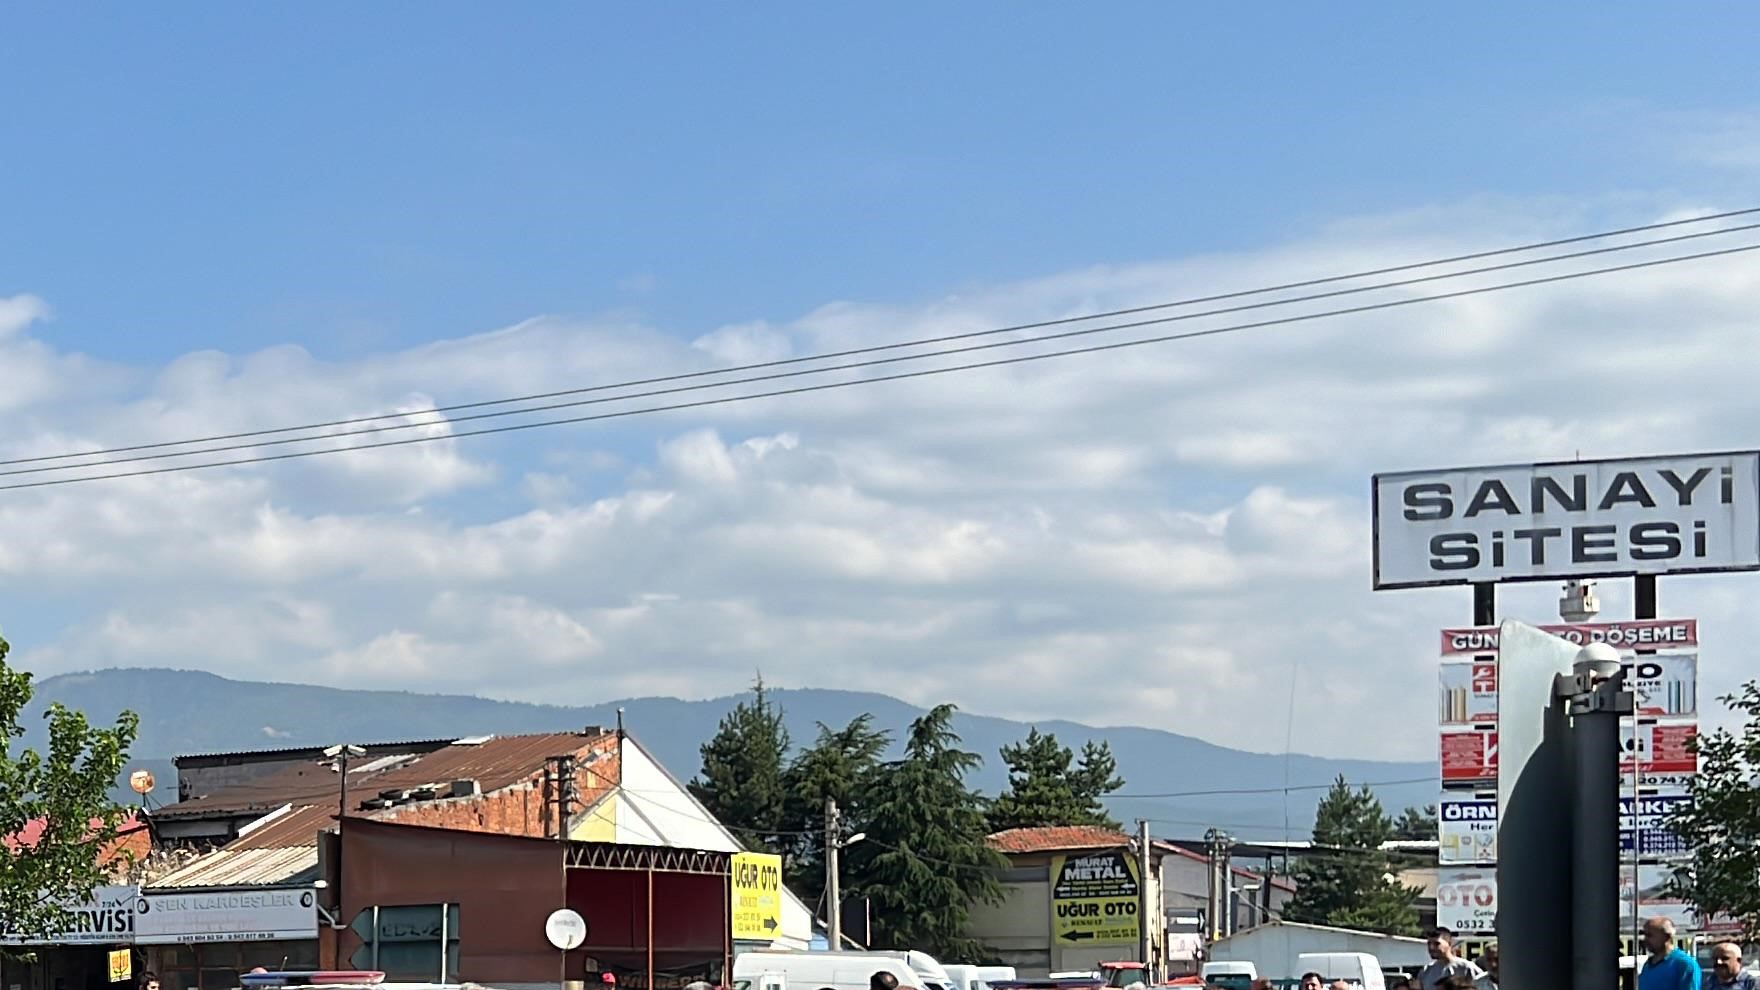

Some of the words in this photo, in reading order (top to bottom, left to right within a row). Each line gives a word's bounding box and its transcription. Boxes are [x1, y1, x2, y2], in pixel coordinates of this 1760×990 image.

[1590, 624, 1687, 646] DÖŞEME
[1471, 823, 1494, 831] Her
[1074, 857, 1115, 868] MURAT
[734, 857, 758, 889] UĞUR
[761, 865, 778, 891] OTO
[1064, 865, 1127, 880] METAL
[1438, 885, 1494, 906] OTO
[1057, 901, 1100, 918] UĞUR
[1104, 902, 1137, 915] OTO
[1456, 920, 1484, 929] 0532
